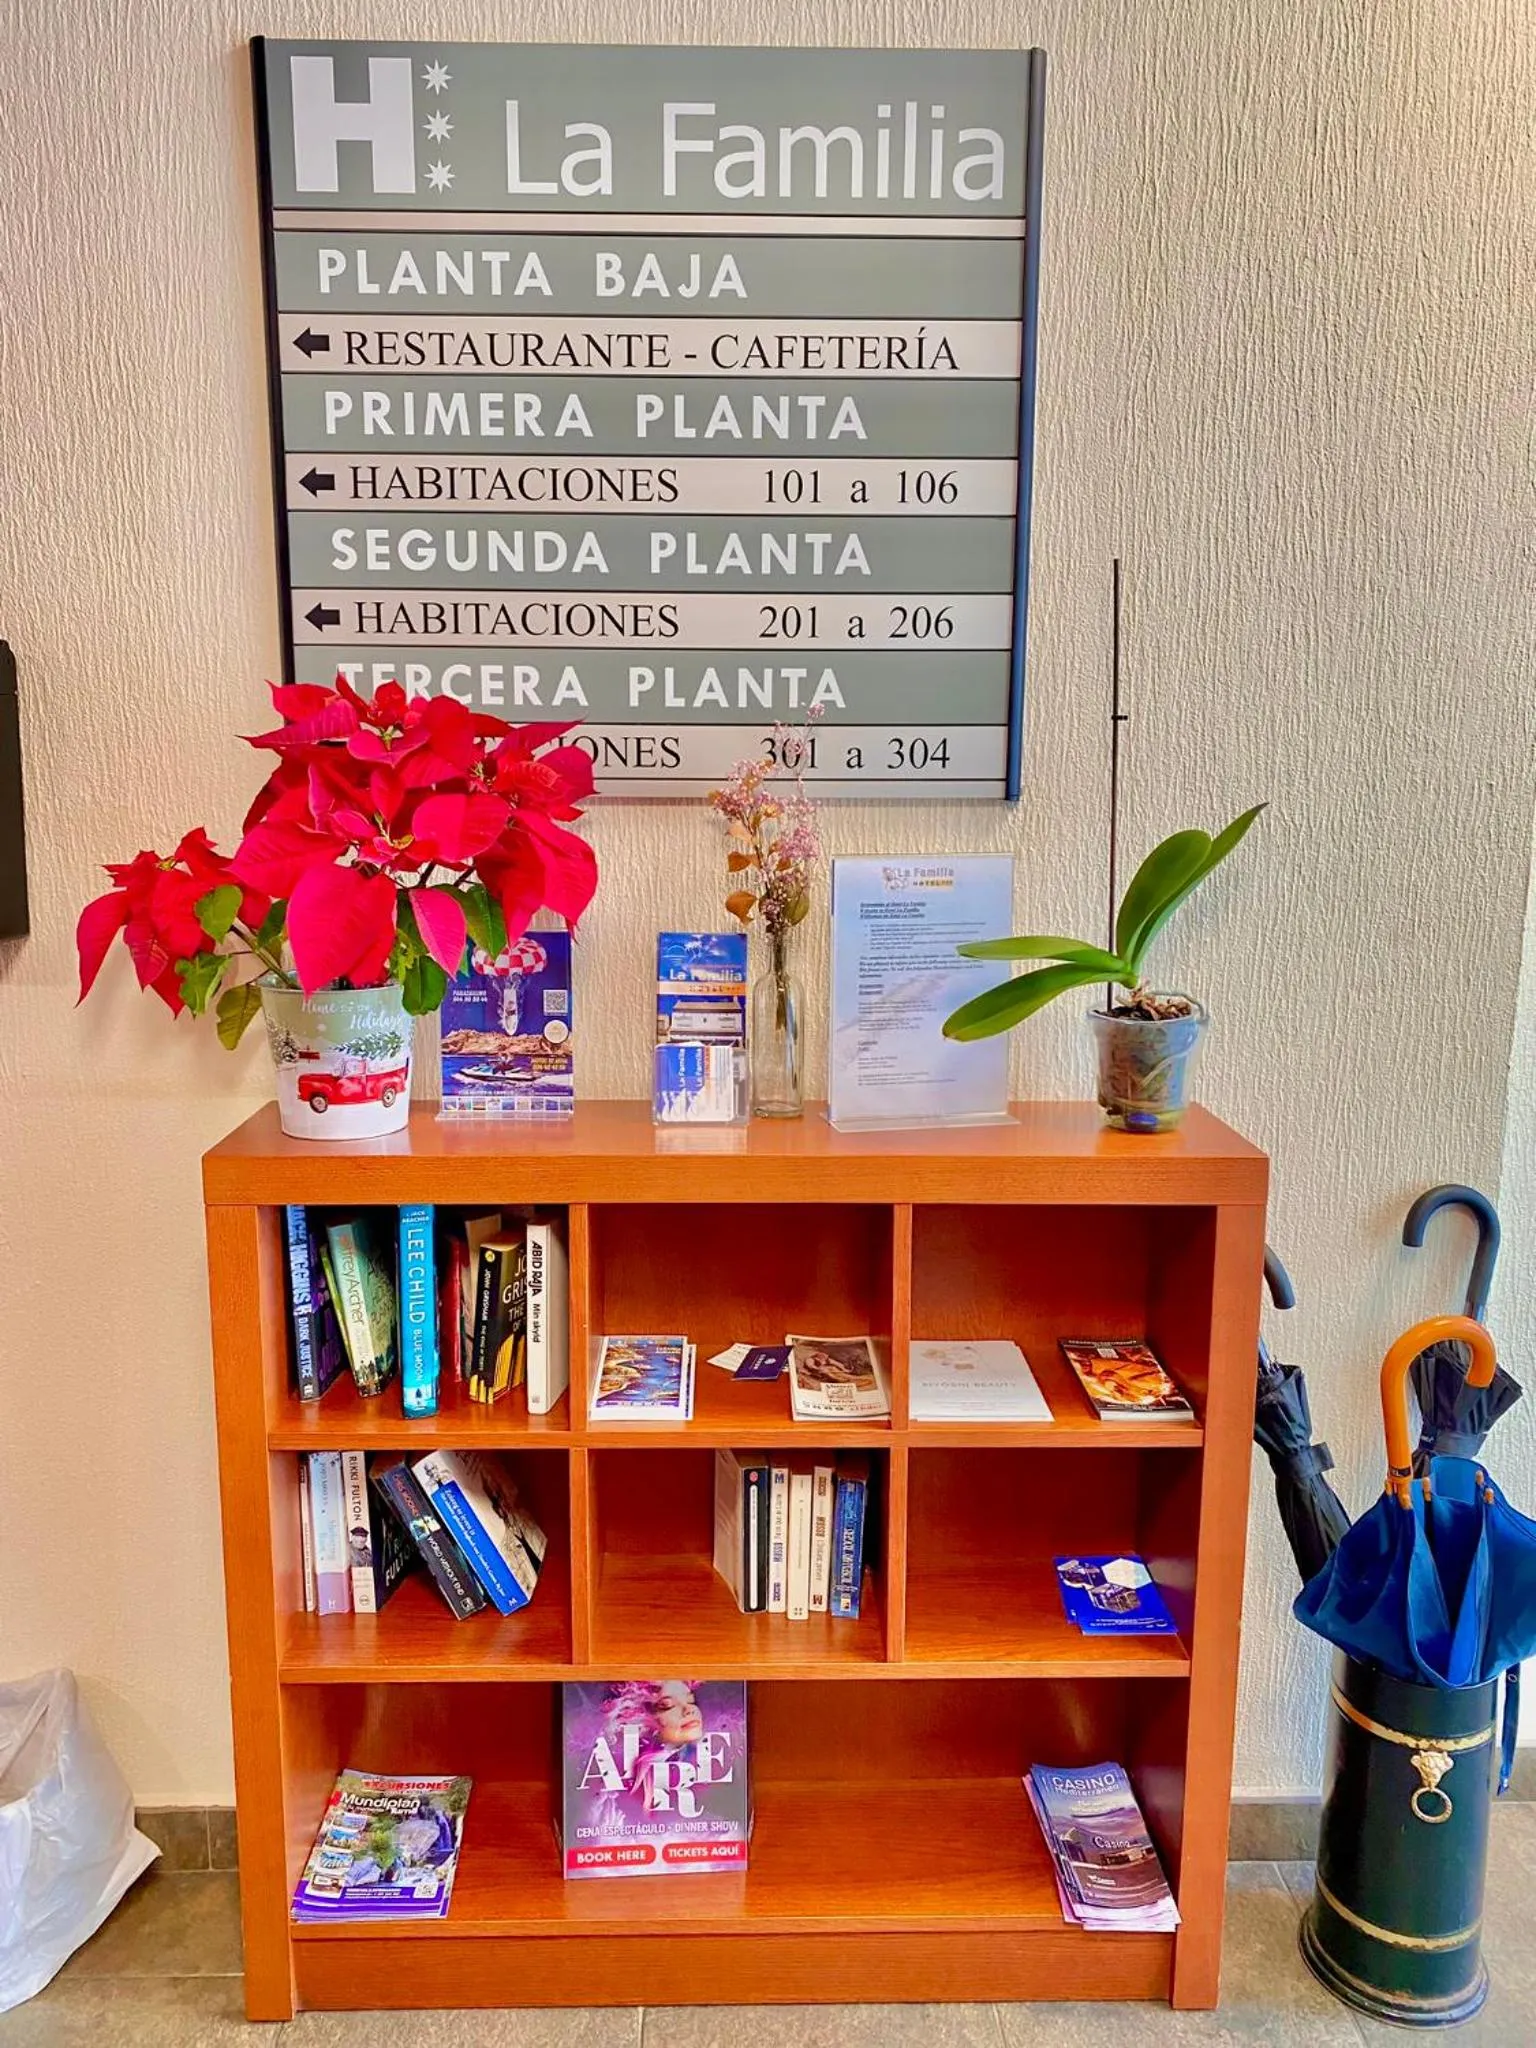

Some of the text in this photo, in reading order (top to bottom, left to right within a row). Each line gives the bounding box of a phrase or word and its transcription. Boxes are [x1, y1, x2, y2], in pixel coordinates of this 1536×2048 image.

[290, 56, 415, 194] H
[505, 100, 1004, 200] La Familia
[317, 249, 748, 299] PLANTA BAJA
[343, 331, 670, 370] RESTAURANTE
[711, 325, 960, 372] CAFETERÍA
[325, 391, 868, 440] PRIMERA PLANTA
[350, 466, 959, 504] HABITACIONES 101 a 106
[332, 528, 872, 576] SEGUNDA PLANTA
[354, 601, 954, 640] HABITACIONES 201 a 206
[628, 667, 847, 709] PLANTA
[760, 736, 950, 770] 301 a 304
[407, 1229, 425, 1324] LEE CHILD
[527, 1241, 542, 1296] ABID RAJA
[300, 1341, 313, 1378] JUSTICE
[413, 1329, 424, 1381] BLUE MOON
[349, 1456, 362, 1521] RIKKI FULTON
[427, 1536, 465, 1596] WORLD WITHOUT END
[576, 1723, 733, 1818] AIRE
[1052, 1773, 1116, 1791] CASINO
[340, 1792, 421, 1810] Mundiplan
[577, 1826, 601, 1838] CENA
[603, 1821, 666, 1837] ESPECTÁCULO
[675, 1822, 708, 1833] DINNER
[710, 1820, 738, 1832] SHOW
[1094, 1835, 1131, 1849] Casino
[577, 1845, 739, 1863] BOOK HERE TICKETS AQUÍ
